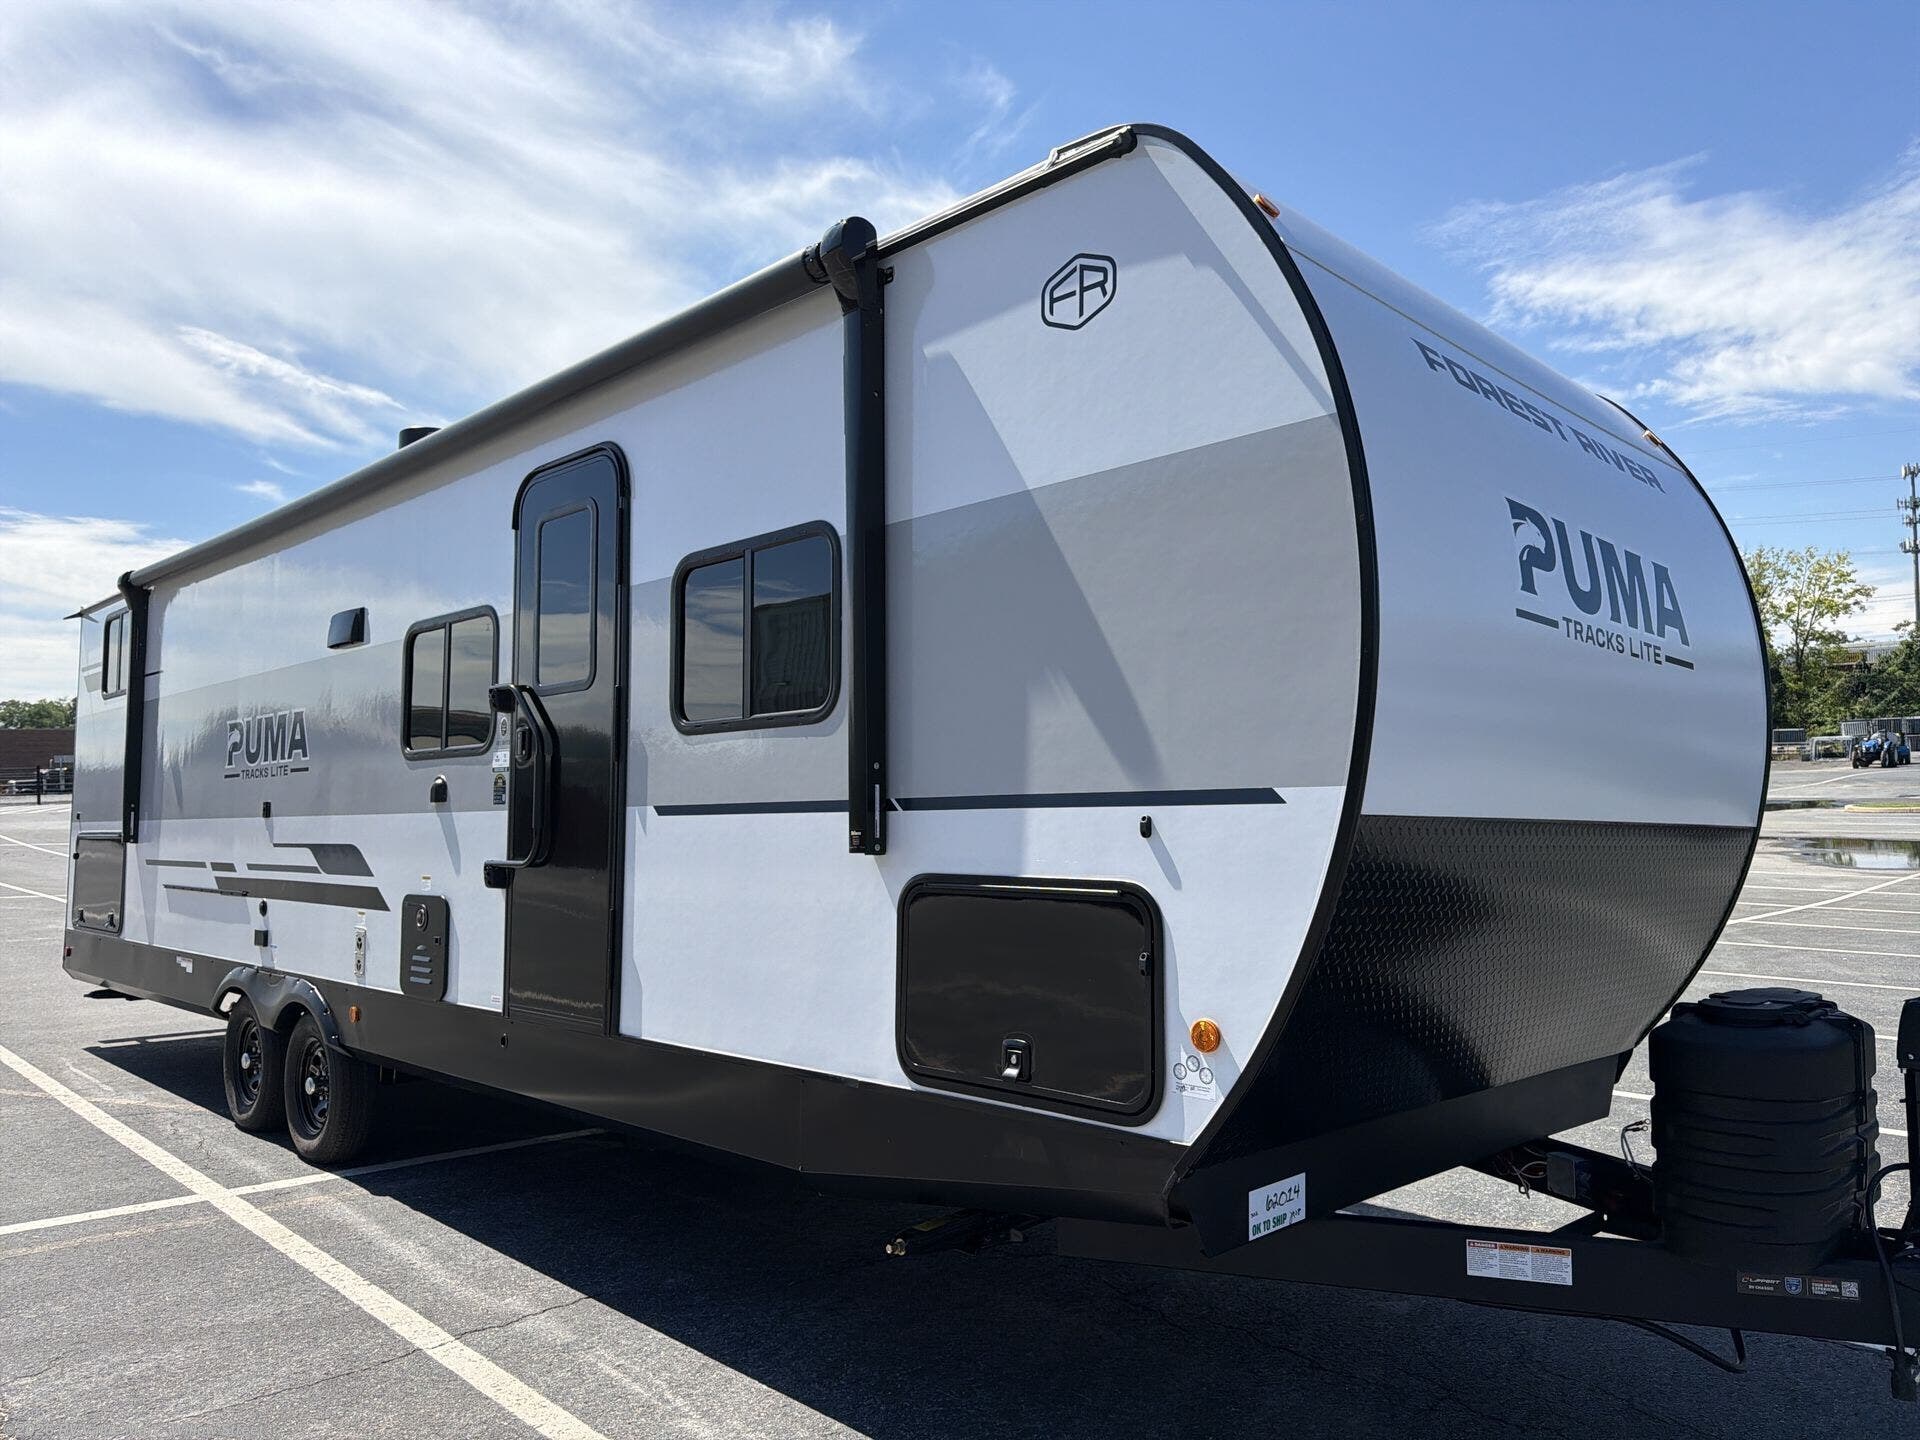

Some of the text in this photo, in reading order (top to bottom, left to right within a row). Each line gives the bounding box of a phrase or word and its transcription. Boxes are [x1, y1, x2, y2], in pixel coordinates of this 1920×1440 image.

[1410, 337, 1666, 494] FOREST RIVER
[1504, 496, 1690, 647] PUMA
[1562, 616, 1663, 665] TRACKS LITE
[226, 708, 309, 768] PUMA
[241, 765, 289, 780] TRACKS LITE
[1266, 1184, 1300, 1212] 62014
[1252, 1223, 1262, 1236] OK
[1263, 1219, 1271, 1231] TO
[1272, 1213, 1287, 1228] SHIP
